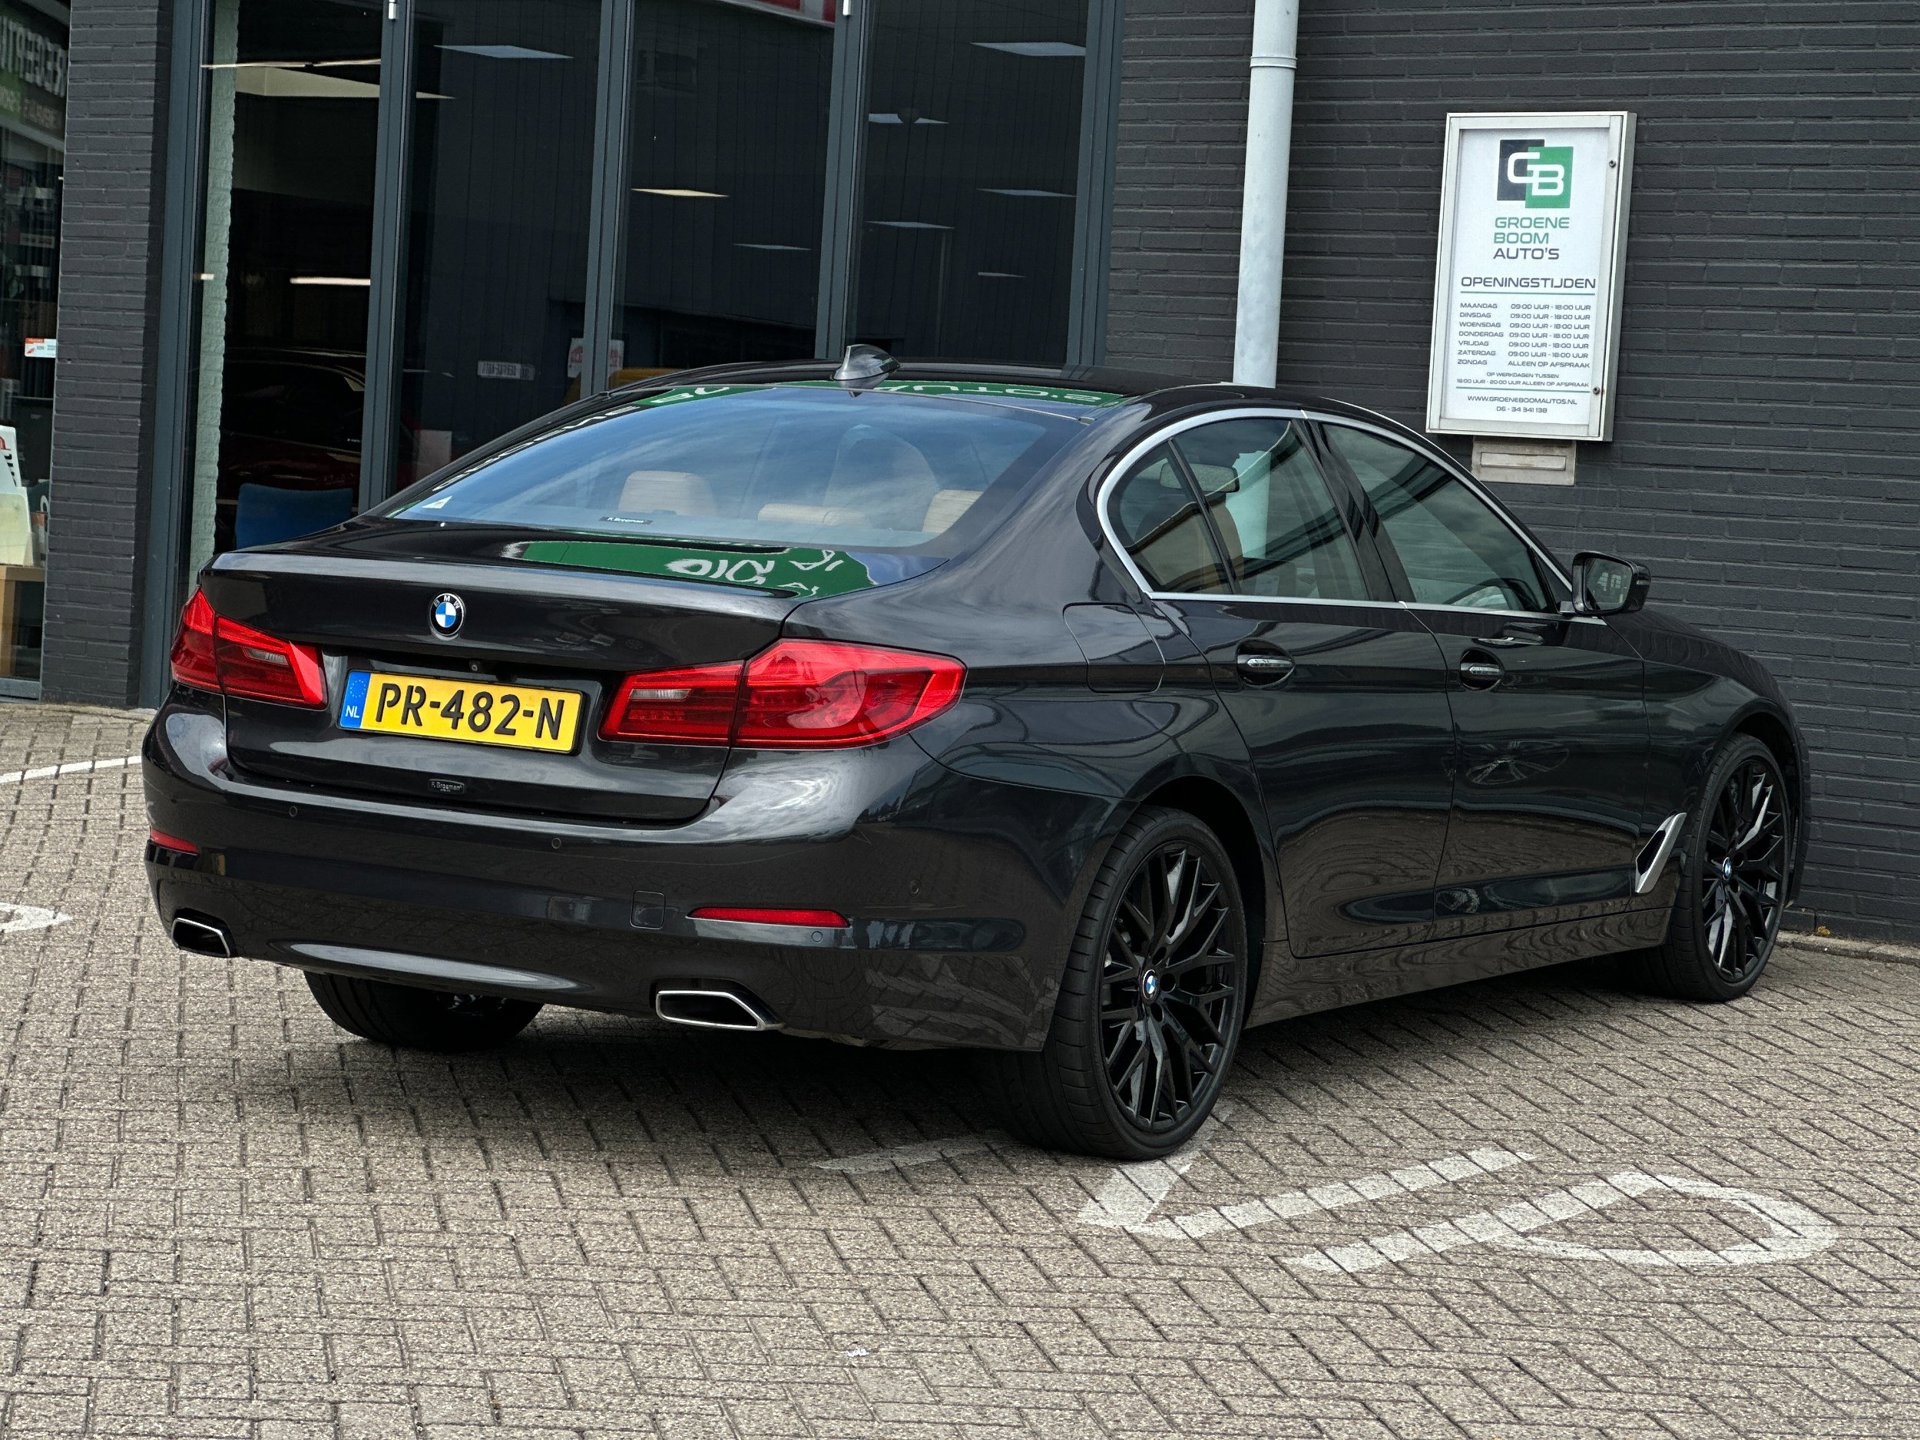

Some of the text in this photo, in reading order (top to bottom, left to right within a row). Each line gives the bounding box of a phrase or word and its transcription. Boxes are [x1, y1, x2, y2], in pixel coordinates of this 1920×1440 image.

[1495, 217, 1570, 229] GROENE
[1493, 232, 1550, 244] BOOM
[1493, 247, 1560, 260] AUTO'S
[1460, 276, 1597, 289] OPENINGSTIJDEN
[1467, 395, 1578, 405] WWW.GROENEBOOMAUTOS.NL
[345, 705, 360, 719] NL
[375, 682, 565, 741] PR-482-N
